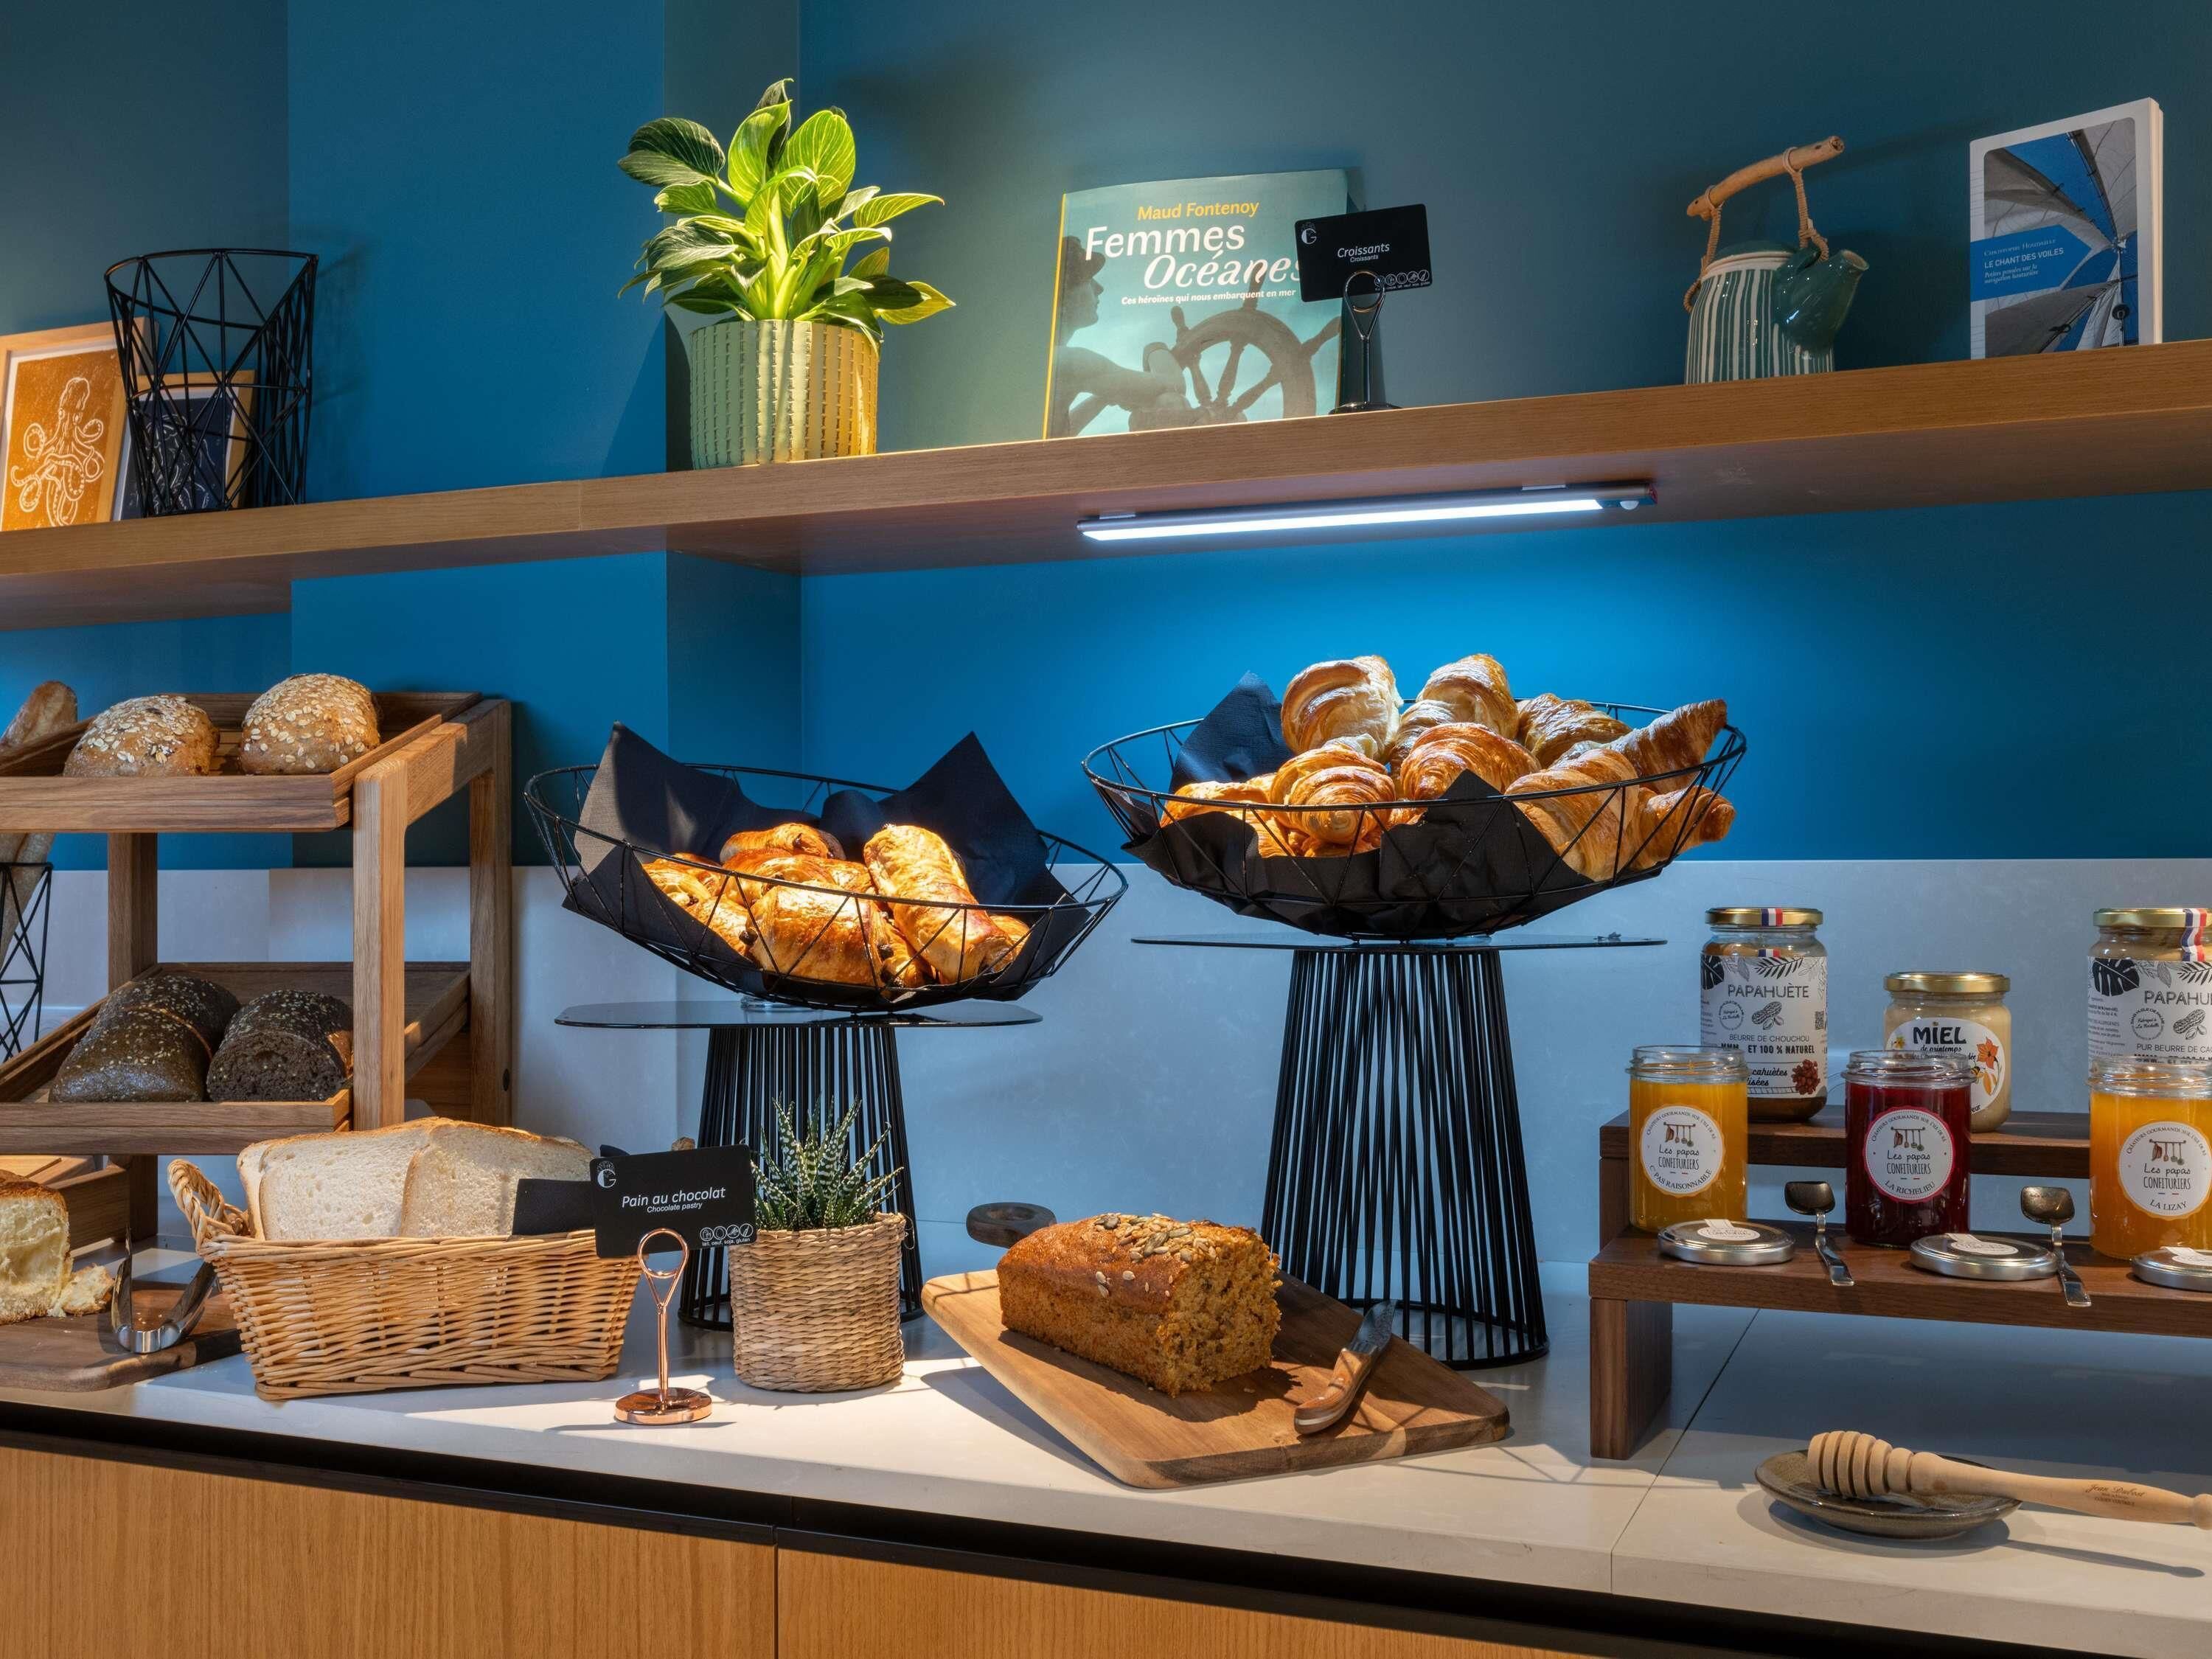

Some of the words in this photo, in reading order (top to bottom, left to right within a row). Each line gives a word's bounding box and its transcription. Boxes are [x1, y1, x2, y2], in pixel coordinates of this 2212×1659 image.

[1138, 204, 1182, 220] Maud
[1186, 201, 1259, 218] Fontenoy
[1085, 224, 1245, 260] Femmes
[1338, 243, 1391, 258] Croissants
[1350, 254, 1379, 262] Croissants
[1984, 260, 1994, 268] LE
[1995, 255, 2020, 266] CHANT
[2021, 254, 2037, 262] DES
[2038, 248, 2064, 258] VOILES
[1121, 296, 1137, 305] Ces
[1138, 295, 1175, 304] héroïnes
[1176, 294, 1189, 303] qui
[1212, 290, 1265, 301] embarquent
[1278, 289, 1296, 297] mer
[1728, 983, 1809, 998] PAPAHUÈTE
[2144, 990, 2212, 1006] PAPAHU
[1729, 1034, 1755, 1042] BEURRE
[1769, 1034, 1810, 1043] CHOUCHOU
[1748, 1045, 1757, 1054] ET
[1760, 1046, 1774, 1054] 100
[1776, 1046, 1783, 1054] %
[1785, 1045, 1815, 1054] NATUREL
[2137, 1043, 2153, 1051] PUR
[2154, 1044, 2186, 1053] BEURRE
[1751, 1067, 1788, 1076] cahuètes
[1659, 1144, 1673, 1155] Les
[1677, 1150, 1700, 1158] papas
[1888, 1150, 1902, 1160] Les
[1907, 1154, 1930, 1163] papas
[1658, 1157, 1700, 1170] CONFITURIERS
[1888, 1163, 1931, 1175] CONFITURIERS
[2144, 1163, 2160, 1173] Les
[2166, 1168, 2191, 1177] papas
[1654, 1172, 1665, 1184] PAS
[1666, 1169, 1712, 1189] RAISONNABLE
[2143, 1176, 2191, 1189] CONFITURIERS
[1885, 1180, 1894, 1190] LA
[1896, 1181, 1935, 1194] RICHELIEU
[622, 1194, 648, 1208] Pain
[653, 1194, 669, 1205] au
[672, 1186, 726, 1203] chocolat
[647, 1203, 680, 1213] Chocolate
[681, 1201, 703, 1212] pastry
[2150, 1200, 2160, 1209] LA
[2163, 1200, 2187, 1211] LIZAY
